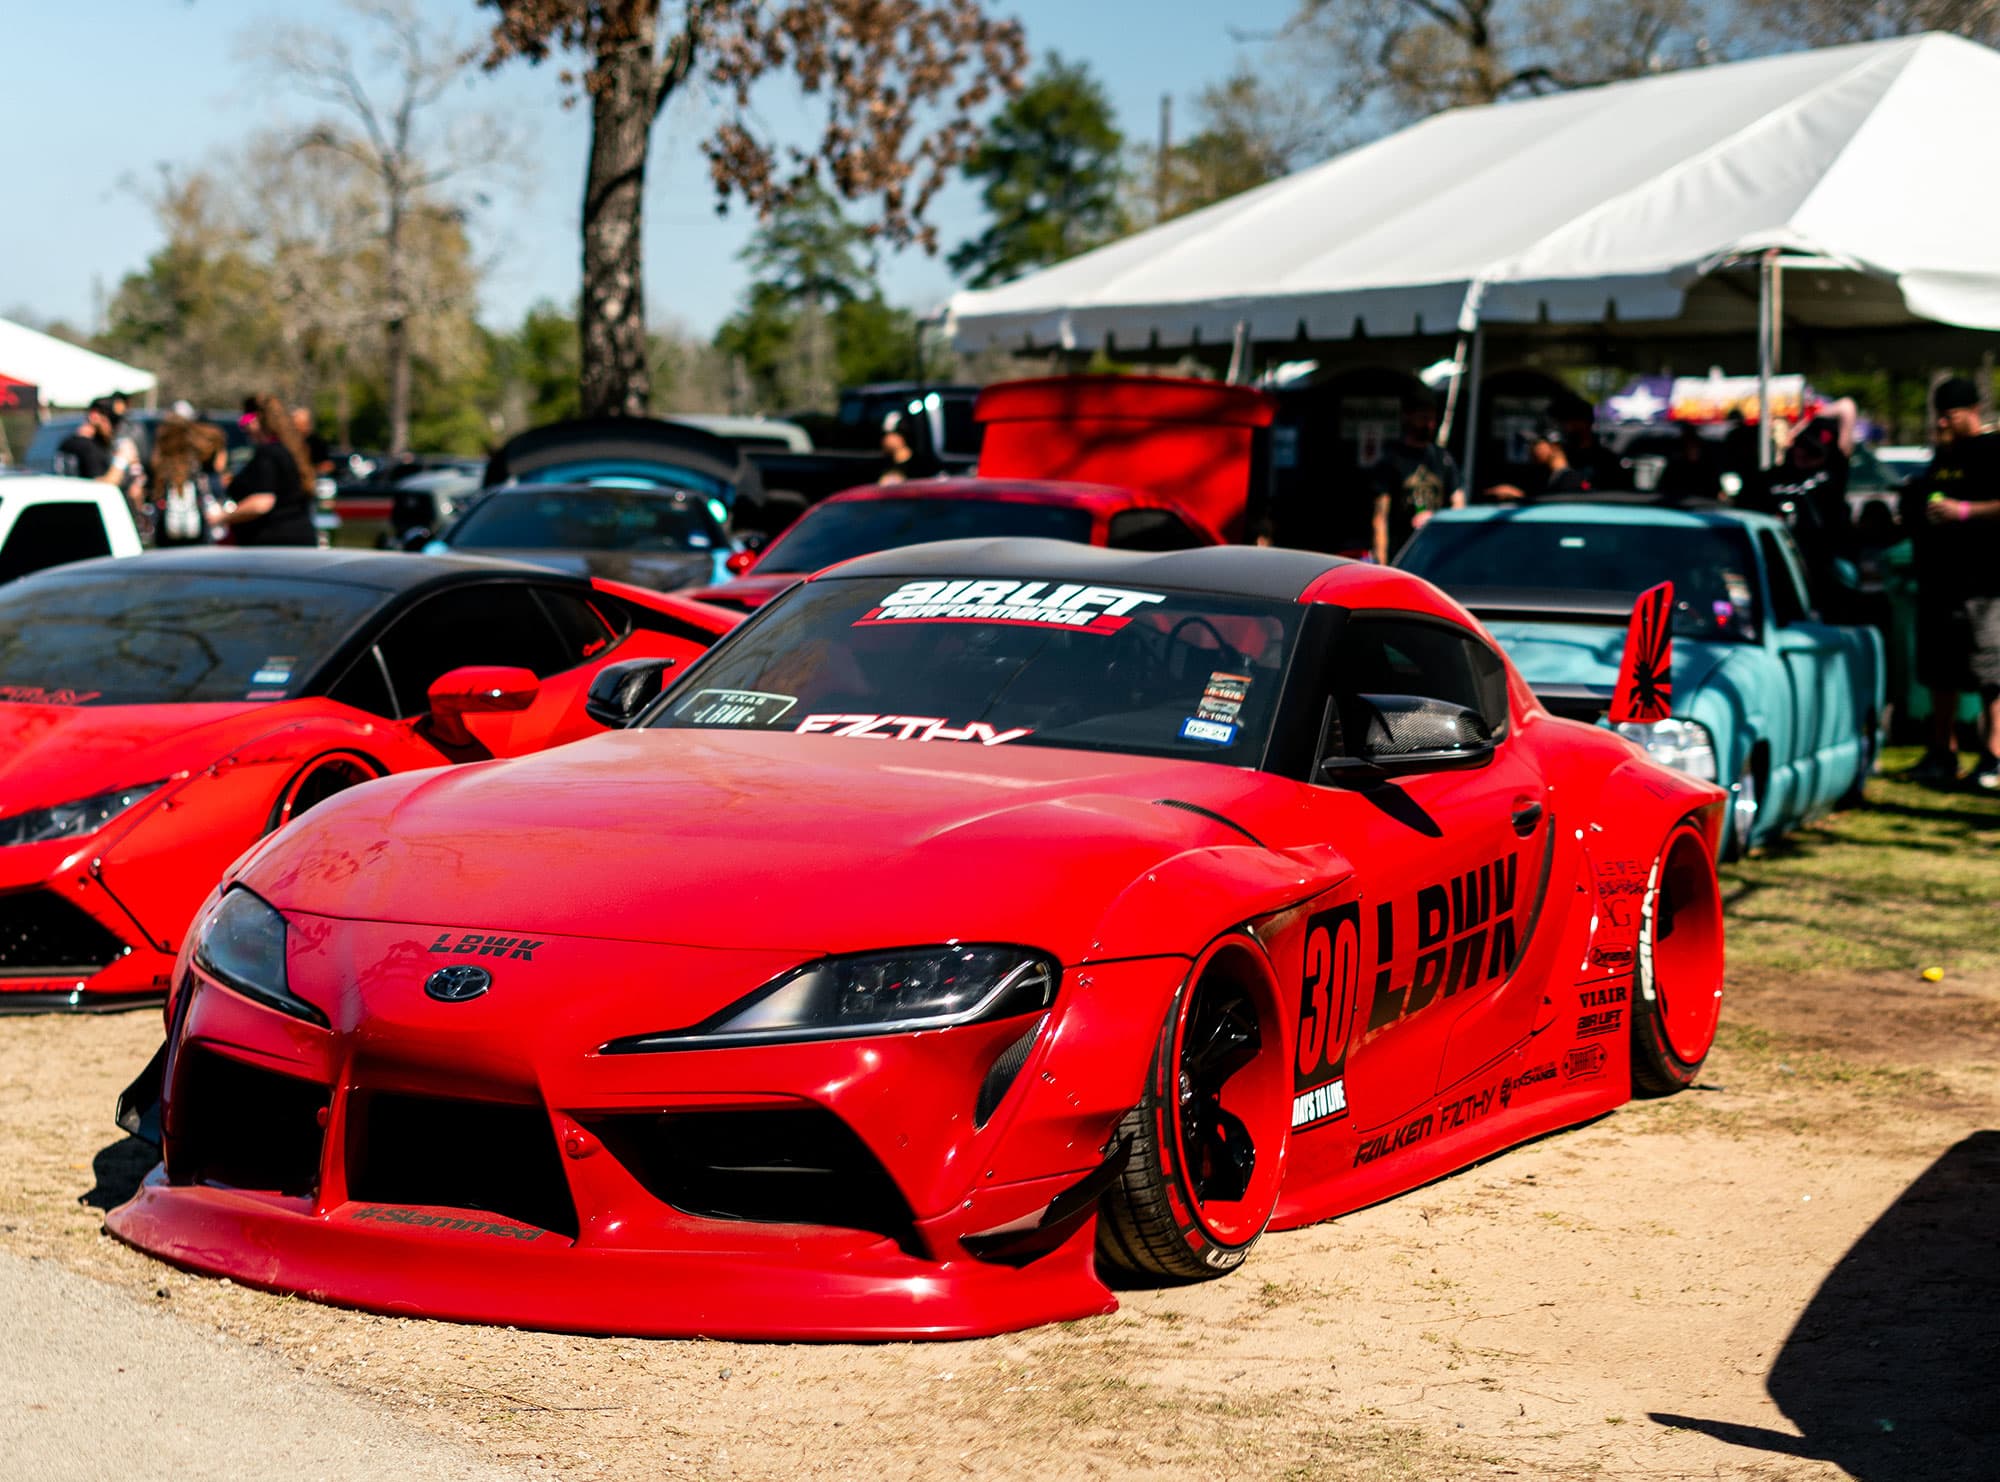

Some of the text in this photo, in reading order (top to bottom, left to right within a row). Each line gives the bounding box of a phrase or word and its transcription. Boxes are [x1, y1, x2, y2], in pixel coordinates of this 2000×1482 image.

[719, 694, 767, 705] TEXAS
[427, 933, 544, 961] LBWK
[1366, 851, 1518, 1033] LBWK
[1298, 918, 1359, 1076] 30
[1579, 986, 1627, 1008] VIAIR
[1291, 1079, 1347, 1127] DAYS TO LIVE
[1352, 1114, 1434, 1169] FALKEN
